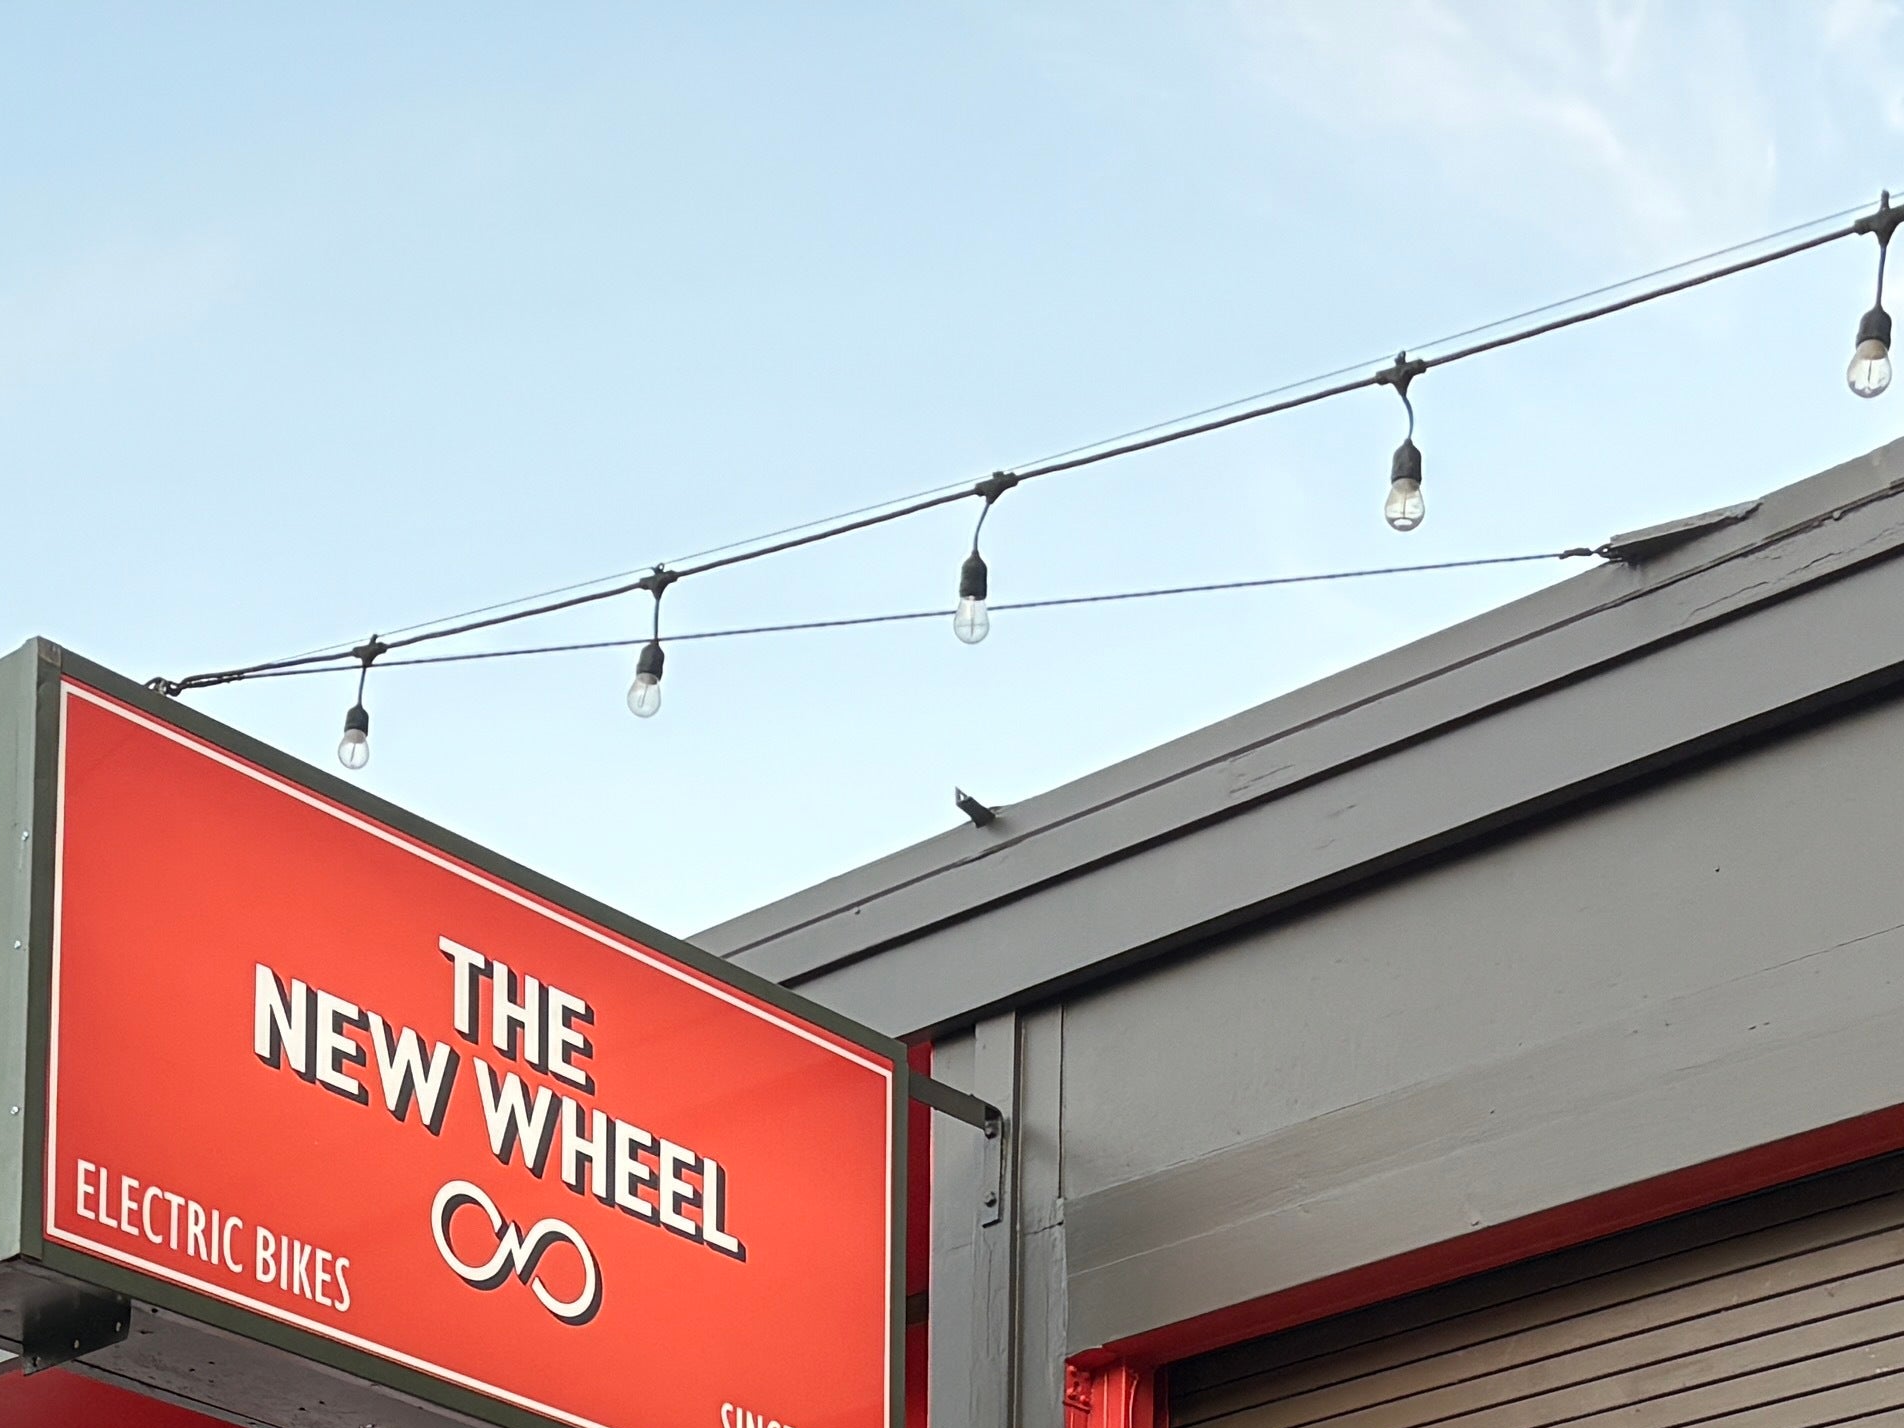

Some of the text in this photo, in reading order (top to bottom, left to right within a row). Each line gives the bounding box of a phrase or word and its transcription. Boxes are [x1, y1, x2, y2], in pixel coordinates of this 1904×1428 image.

[439, 937, 594, 1091] THE
[253, 963, 746, 1261] NEW WHEEL
[76, 1158, 352, 1314] ELECTRIC BIKES
